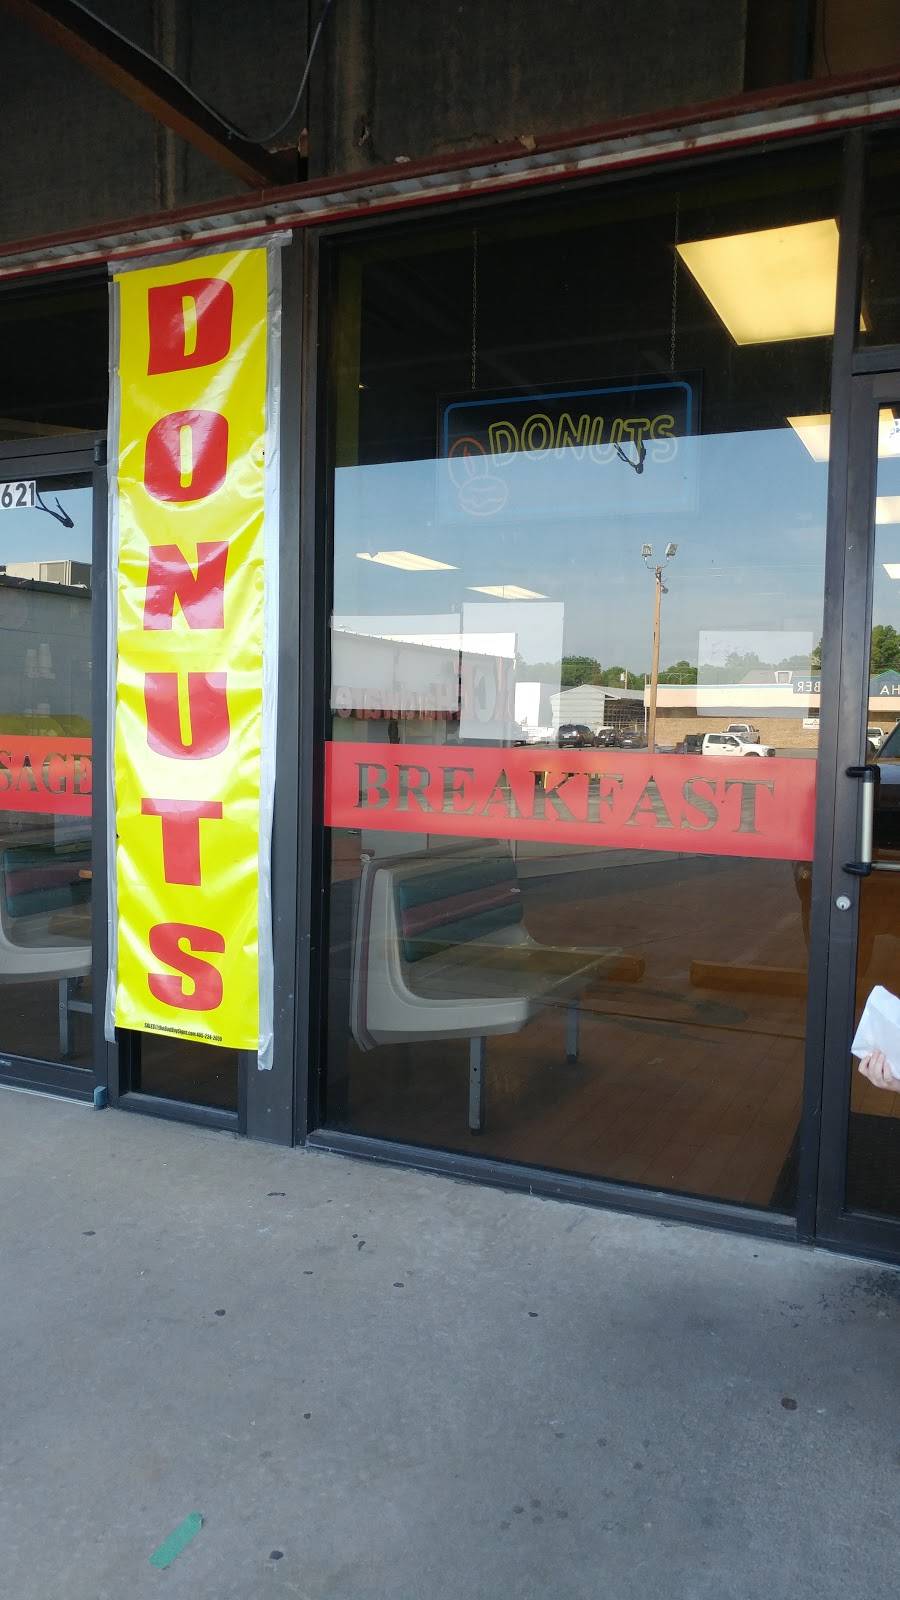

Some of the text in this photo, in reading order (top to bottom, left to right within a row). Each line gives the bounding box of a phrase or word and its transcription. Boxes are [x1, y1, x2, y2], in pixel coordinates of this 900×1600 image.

[488, 413, 678, 466] DONUTS
[1, 482, 35, 508] 621
[141, 278, 233, 1011] DONUTS
[354, 761, 775, 834] BREAKFAST
